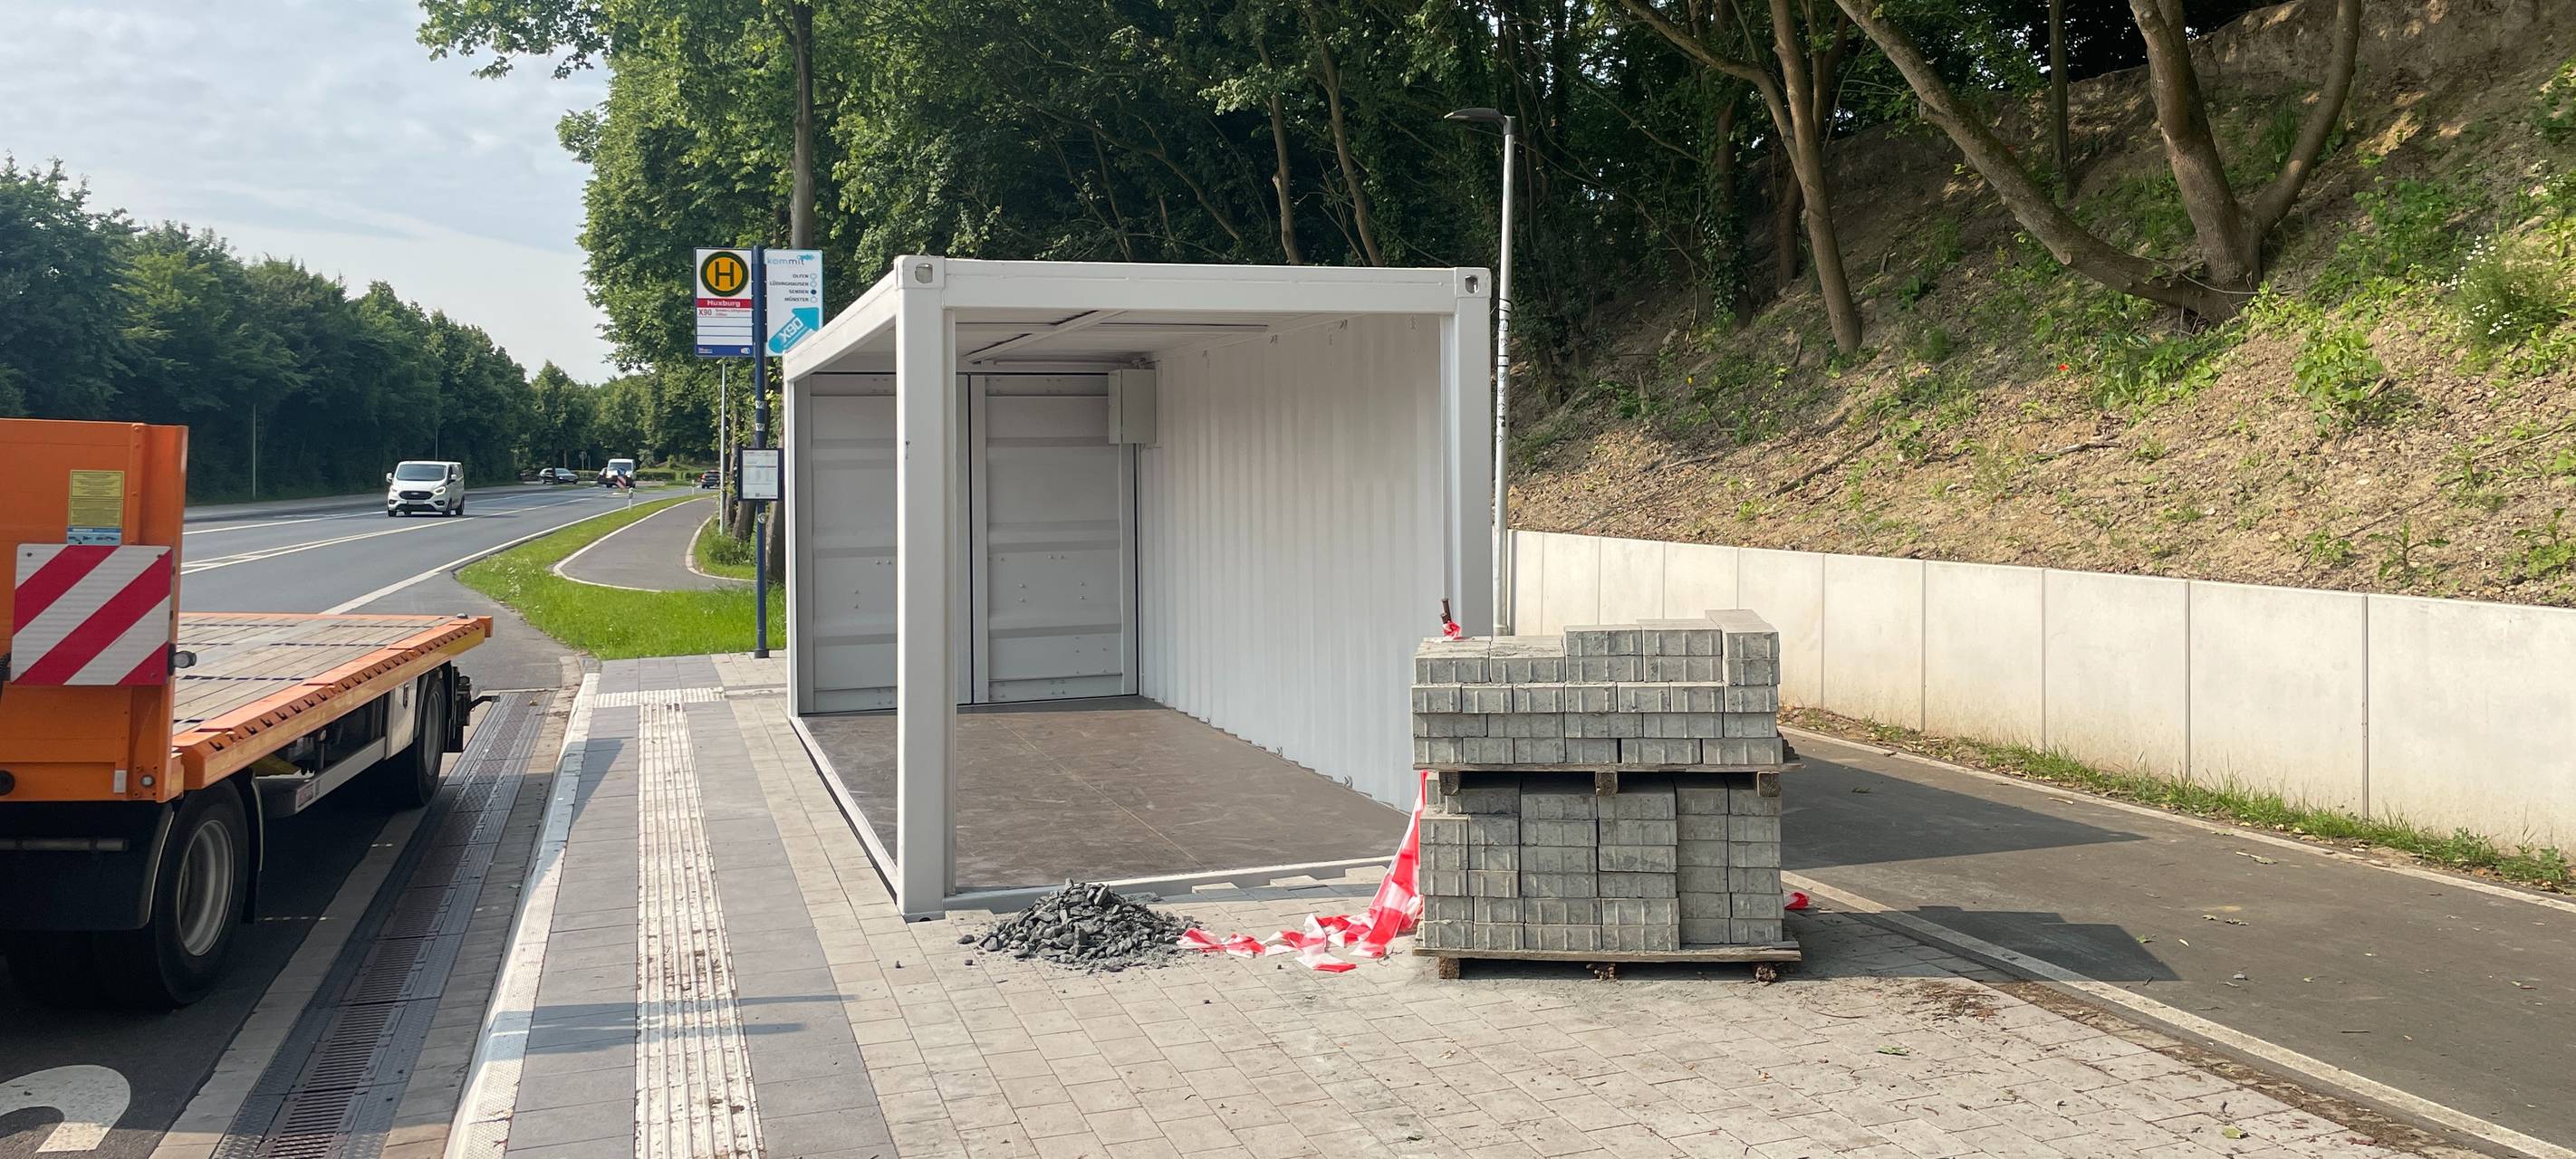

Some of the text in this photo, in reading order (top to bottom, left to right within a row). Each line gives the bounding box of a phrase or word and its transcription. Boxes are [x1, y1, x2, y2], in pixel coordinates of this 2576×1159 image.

[767, 257, 804, 265] kommit
[716, 262, 735, 287] H
[780, 317, 804, 342] X90
